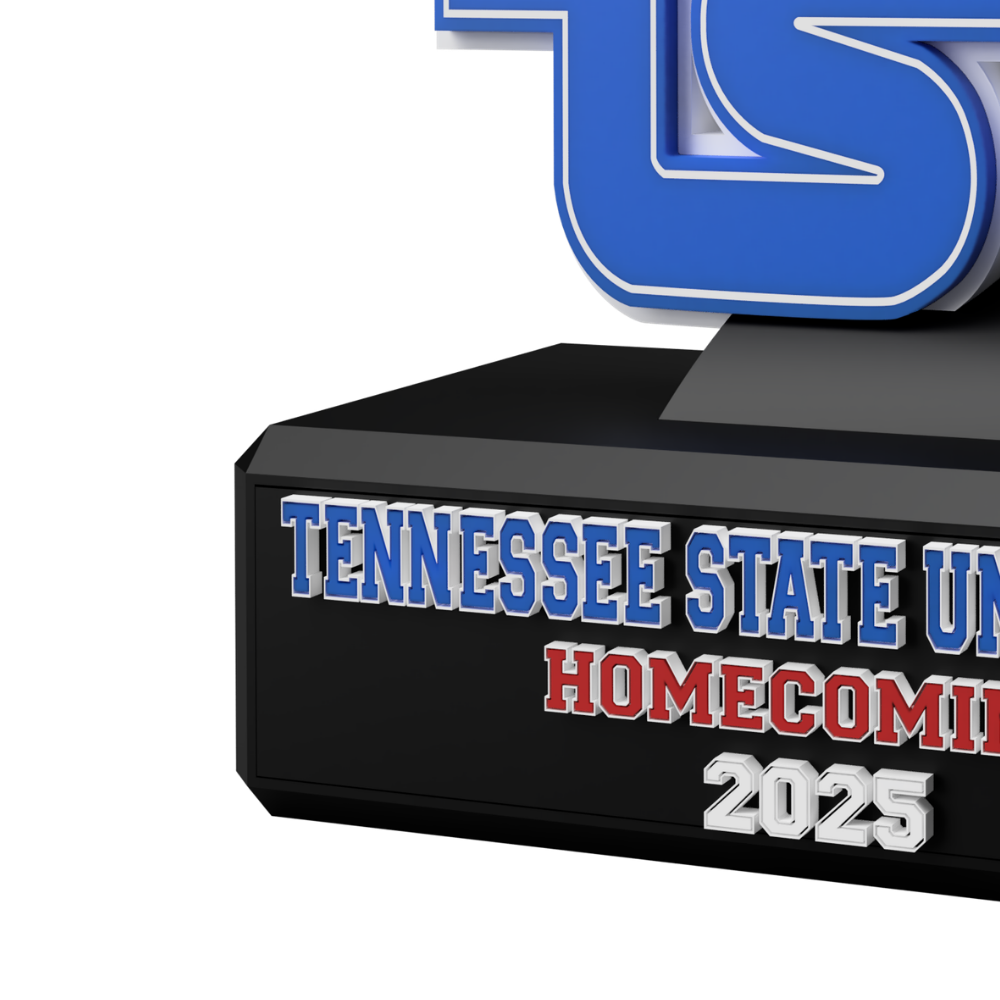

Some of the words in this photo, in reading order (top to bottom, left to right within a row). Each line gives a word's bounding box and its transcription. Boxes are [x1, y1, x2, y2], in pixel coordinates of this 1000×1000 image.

[281, 494, 671, 628] TENNESSEE
[685, 525, 905, 649] STATE
[703, 752, 934, 852] 2025
